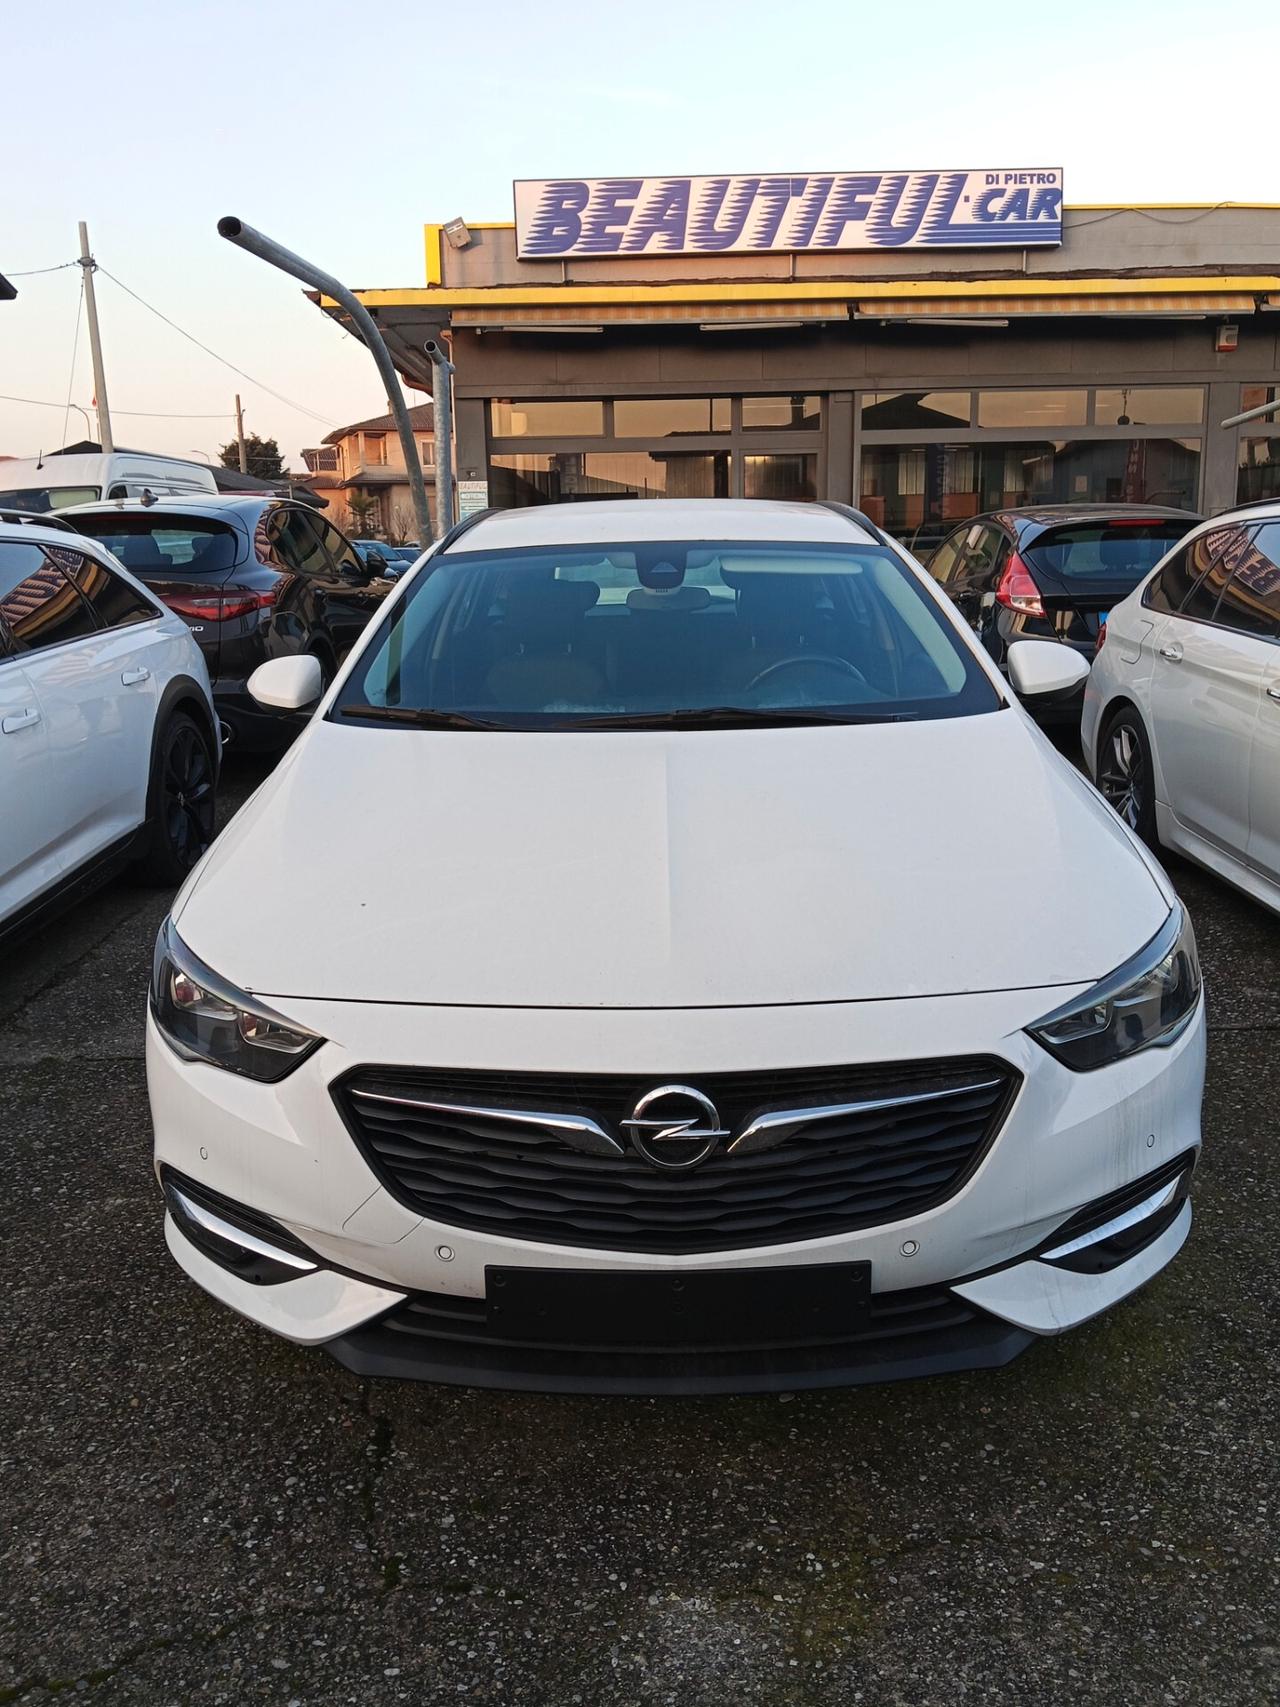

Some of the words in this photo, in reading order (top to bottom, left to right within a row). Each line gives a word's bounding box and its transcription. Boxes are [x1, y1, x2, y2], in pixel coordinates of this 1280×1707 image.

[985, 174, 1000, 185] DI
[1004, 173, 1057, 184] PIETRO
[521, 173, 969, 254] BEAUTIFUL
[972, 188, 1061, 222] CAR
